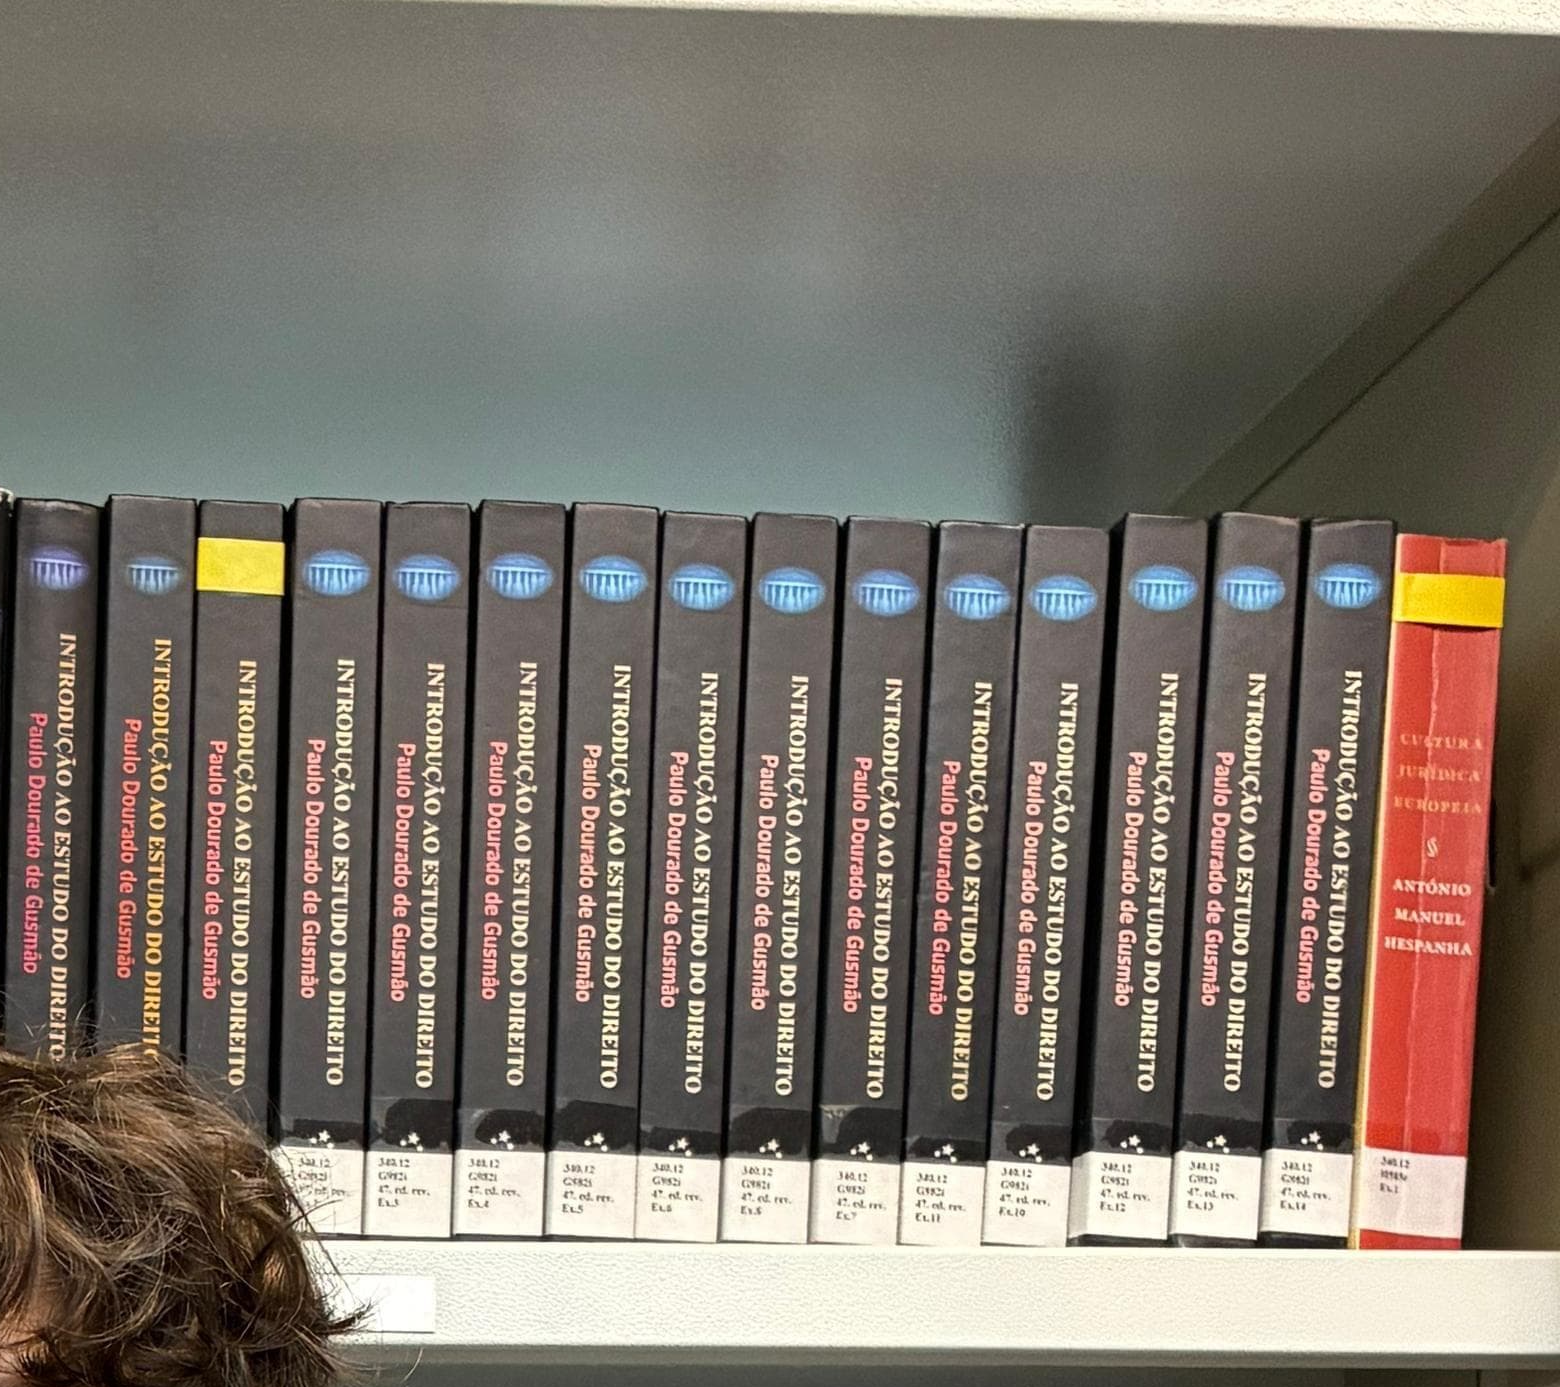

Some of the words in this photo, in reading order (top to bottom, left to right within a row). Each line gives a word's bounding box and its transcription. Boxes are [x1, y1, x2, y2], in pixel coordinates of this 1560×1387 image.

[606, 665, 632, 817] INTRODUÇÃO
[1238, 673, 1267, 824] INTRODUÇÃO
[1398, 732, 1484, 753] CULTURA
[581, 744, 603, 800] Paulo
[1213, 751, 1235, 807] Paulo
[1395, 761, 1481, 784] JURÍDICA
[1392, 796, 1483, 815] EUROPEIA
[578, 805, 601, 889] Dourado
[607, 821, 626, 855] AO
[1207, 812, 1231, 895] Dourado
[1237, 828, 1256, 862] AO
[577, 894, 598, 919] de
[604, 860, 625, 951] ESTUDO
[1392, 878, 1472, 897] ANTÓNIO
[1205, 899, 1226, 924] de
[1232, 866, 1254, 956] ESTUDO
[1394, 907, 1467, 927] MANUEL
[575, 924, 596, 1003] Gusmão
[1201, 929, 1224, 1007] Gusmão
[1383, 936, 1473, 957] HESPANHA
[603, 956, 622, 989] DO
[1229, 960, 1248, 994] DO
[600, 994, 621, 1089] DIREITO
[1223, 998, 1246, 1092] DIREITO
